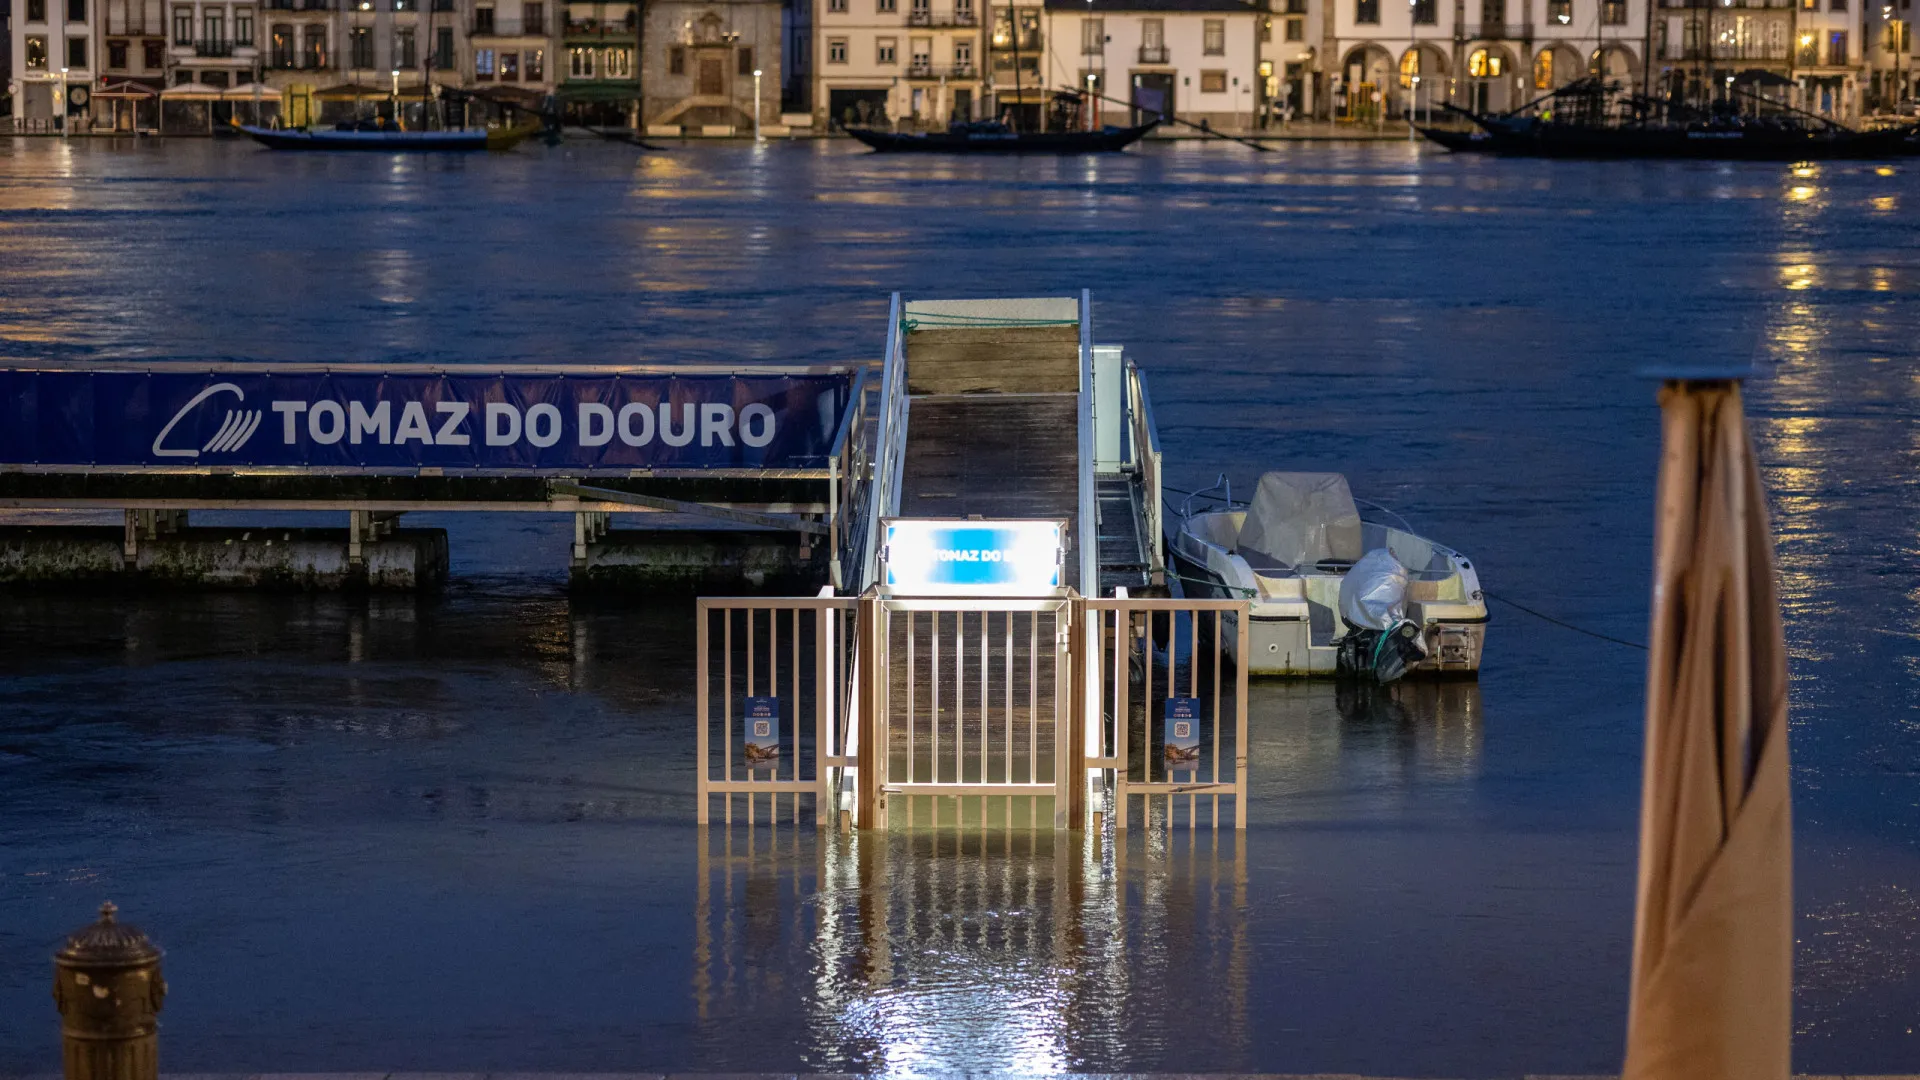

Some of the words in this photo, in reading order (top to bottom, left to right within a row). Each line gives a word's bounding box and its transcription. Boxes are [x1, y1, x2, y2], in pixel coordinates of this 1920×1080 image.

[272, 400, 470, 445] TOMAZ
[486, 402, 562, 447] DO
[578, 402, 776, 448] DOURO
[981, 550, 1002, 562] DO
